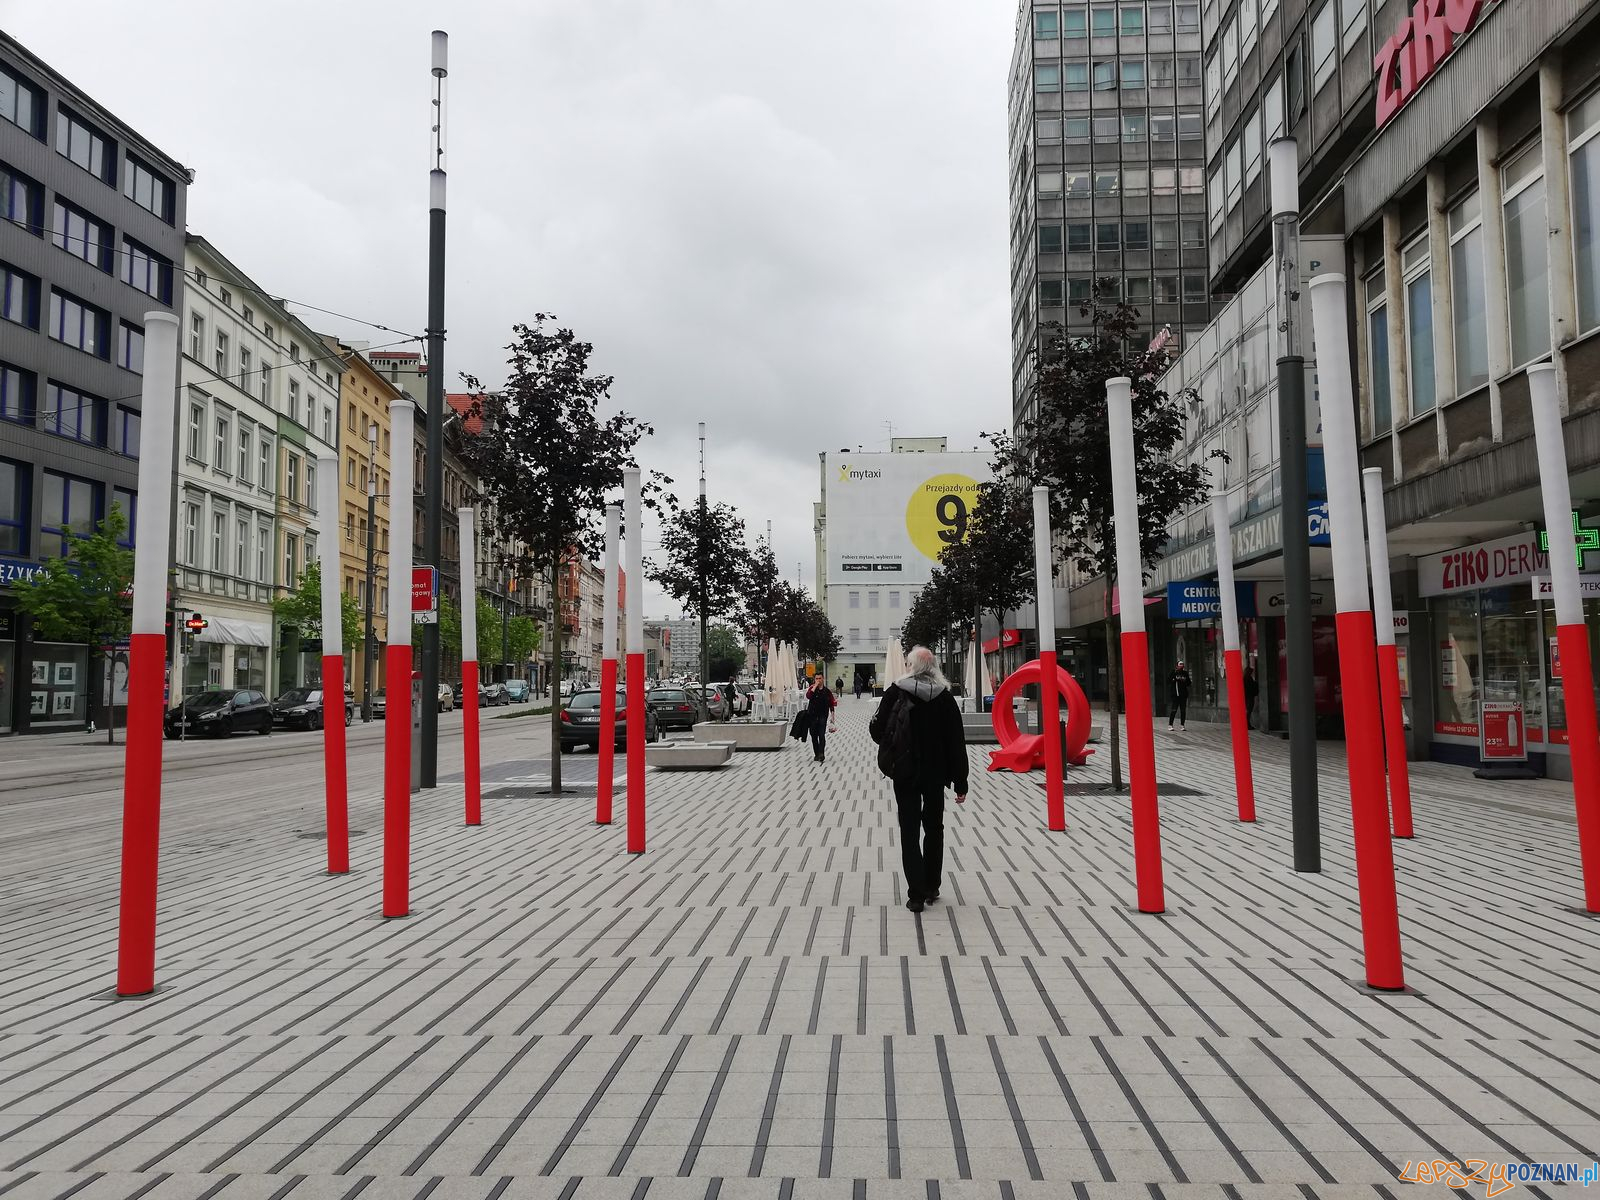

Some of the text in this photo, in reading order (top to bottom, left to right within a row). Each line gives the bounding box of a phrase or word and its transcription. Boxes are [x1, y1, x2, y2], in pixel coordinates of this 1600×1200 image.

[850, 468, 881, 480] mytaxi
[925, 484, 964, 493] Przejazdy
[1170, 543, 1210, 580] MEDYCZNE
